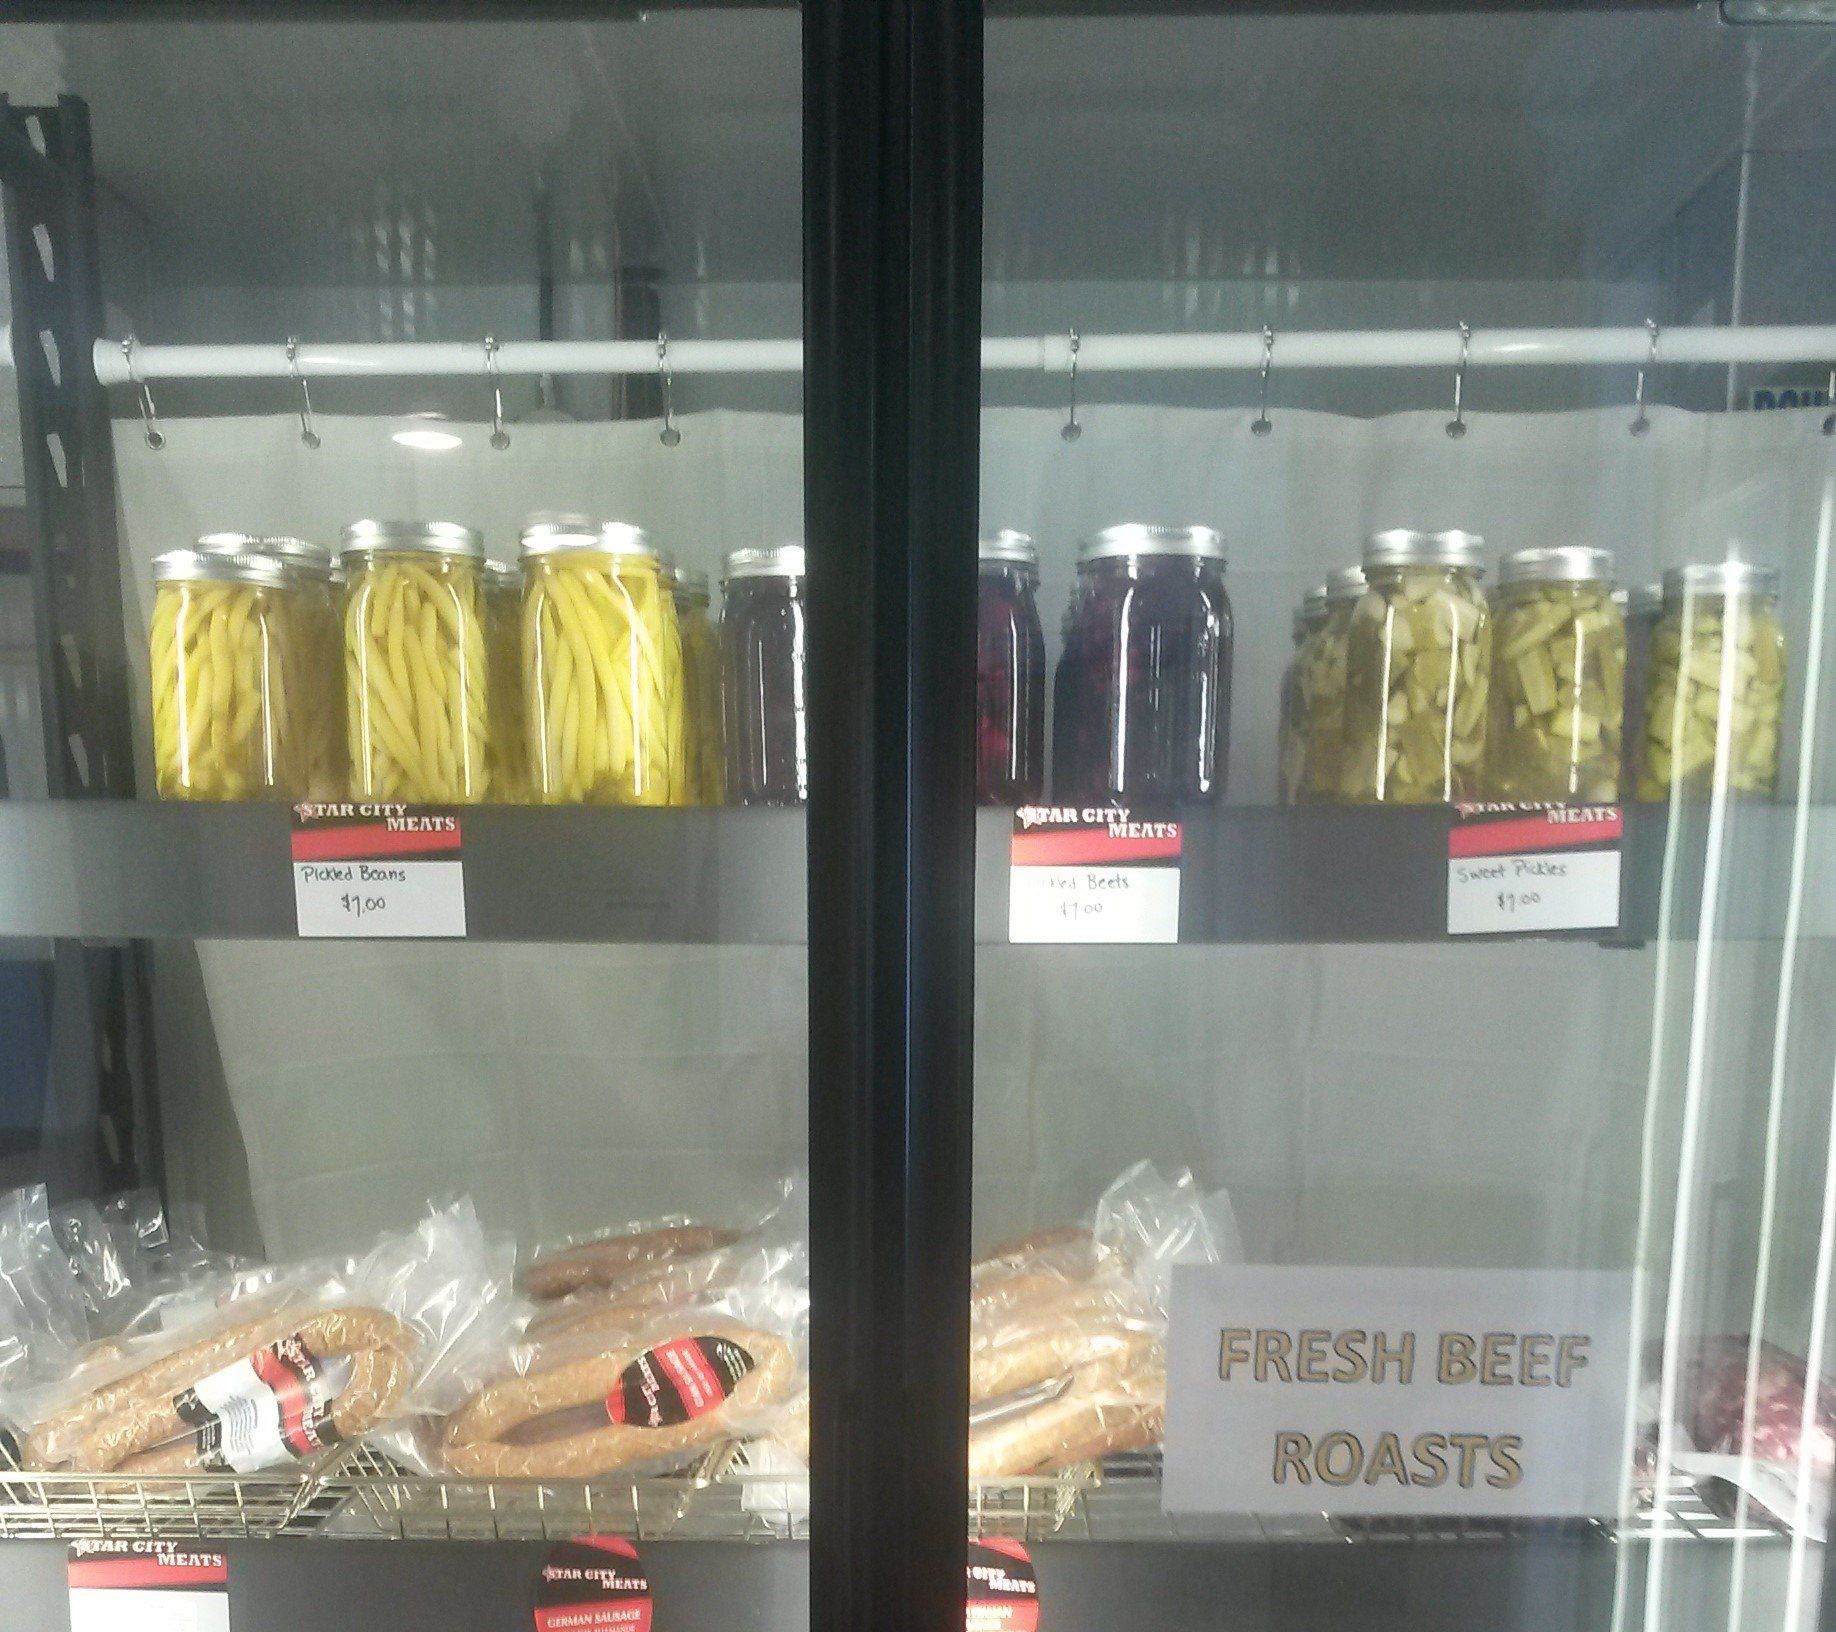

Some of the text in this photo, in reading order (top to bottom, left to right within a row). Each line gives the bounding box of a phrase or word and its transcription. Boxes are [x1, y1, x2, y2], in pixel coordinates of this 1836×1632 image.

[301, 803, 407, 817] STAR CITY
[1082, 807, 1130, 823] CITY
[1547, 806, 1618, 824] MEATS
[386, 816, 456, 832] MEATS
[1108, 822, 1178, 838] MEATS
[301, 865, 407, 883] Pickled Beans
[1087, 873, 1130, 890] Beets
[1457, 863, 1505, 884] Sweet
[1497, 891, 1541, 912] $700
[1060, 901, 1104, 920] $700
[1218, 1327, 1591, 1388] FRESH BEEF
[1273, 1430, 1524, 1489] ROASTS
[132, 1540, 178, 1553] CITY
[157, 1552, 223, 1567] MEATS
[585, 1568, 616, 1581] CITY
[602, 1578, 648, 1590] MEATS
